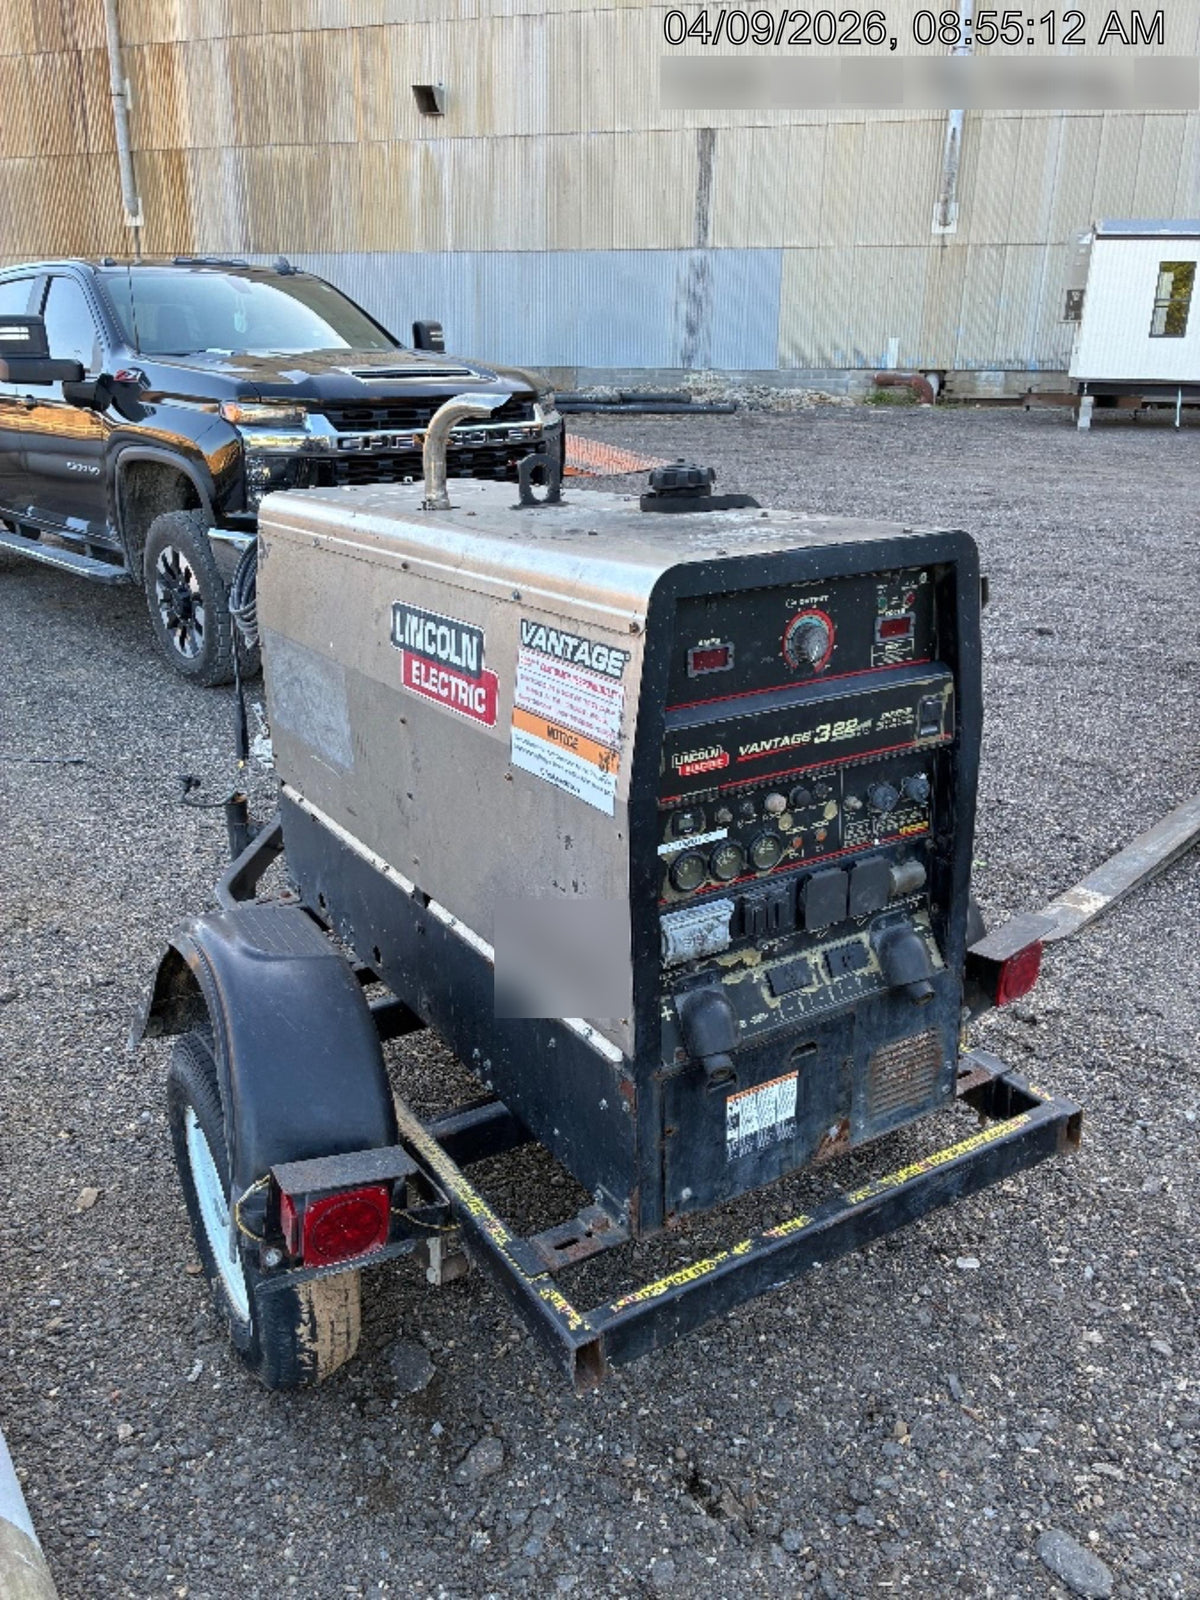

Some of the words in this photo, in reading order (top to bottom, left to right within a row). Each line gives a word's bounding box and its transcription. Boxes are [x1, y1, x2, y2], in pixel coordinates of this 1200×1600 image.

[395, 610, 479, 672] LINCOLN
[521, 621, 626, 679] VANTAGE
[411, 659, 486, 714] ELECTRIC
[738, 731, 812, 756] VANTAGE
